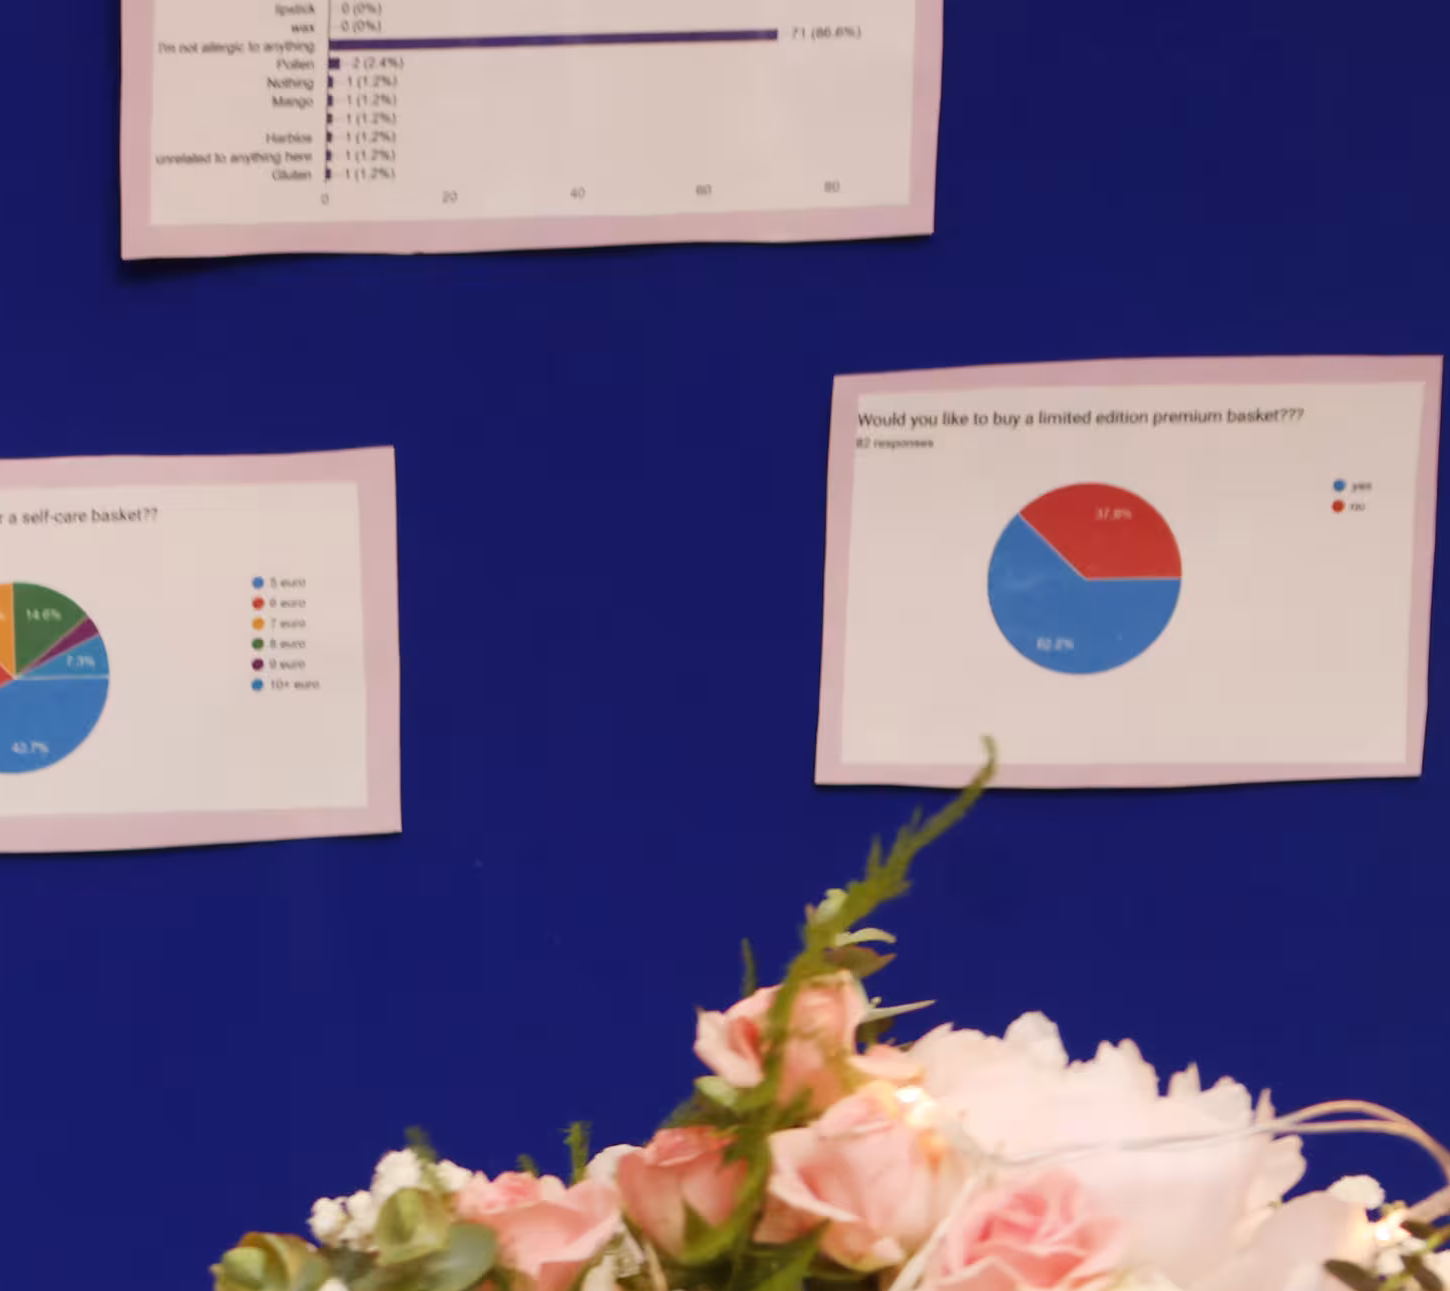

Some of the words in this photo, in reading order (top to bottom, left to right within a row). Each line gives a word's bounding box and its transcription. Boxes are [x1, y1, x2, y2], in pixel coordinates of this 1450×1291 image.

[263, 40, 316, 55] anything
[267, 77, 314, 91] Nothing
[230, 152, 282, 167] anything
[858, 411, 907, 427] Would
[910, 414, 939, 431] you
[942, 411, 969, 426] like
[973, 412, 989, 426] to
[993, 410, 1022, 430] buy
[1038, 409, 1092, 425] limited
[1096, 409, 1150, 425] edition
[1152, 410, 1224, 428] premium
[1227, 408, 1305, 424] basket???
[22, 509, 87, 525] self-care
[90, 507, 159, 523] basket??
